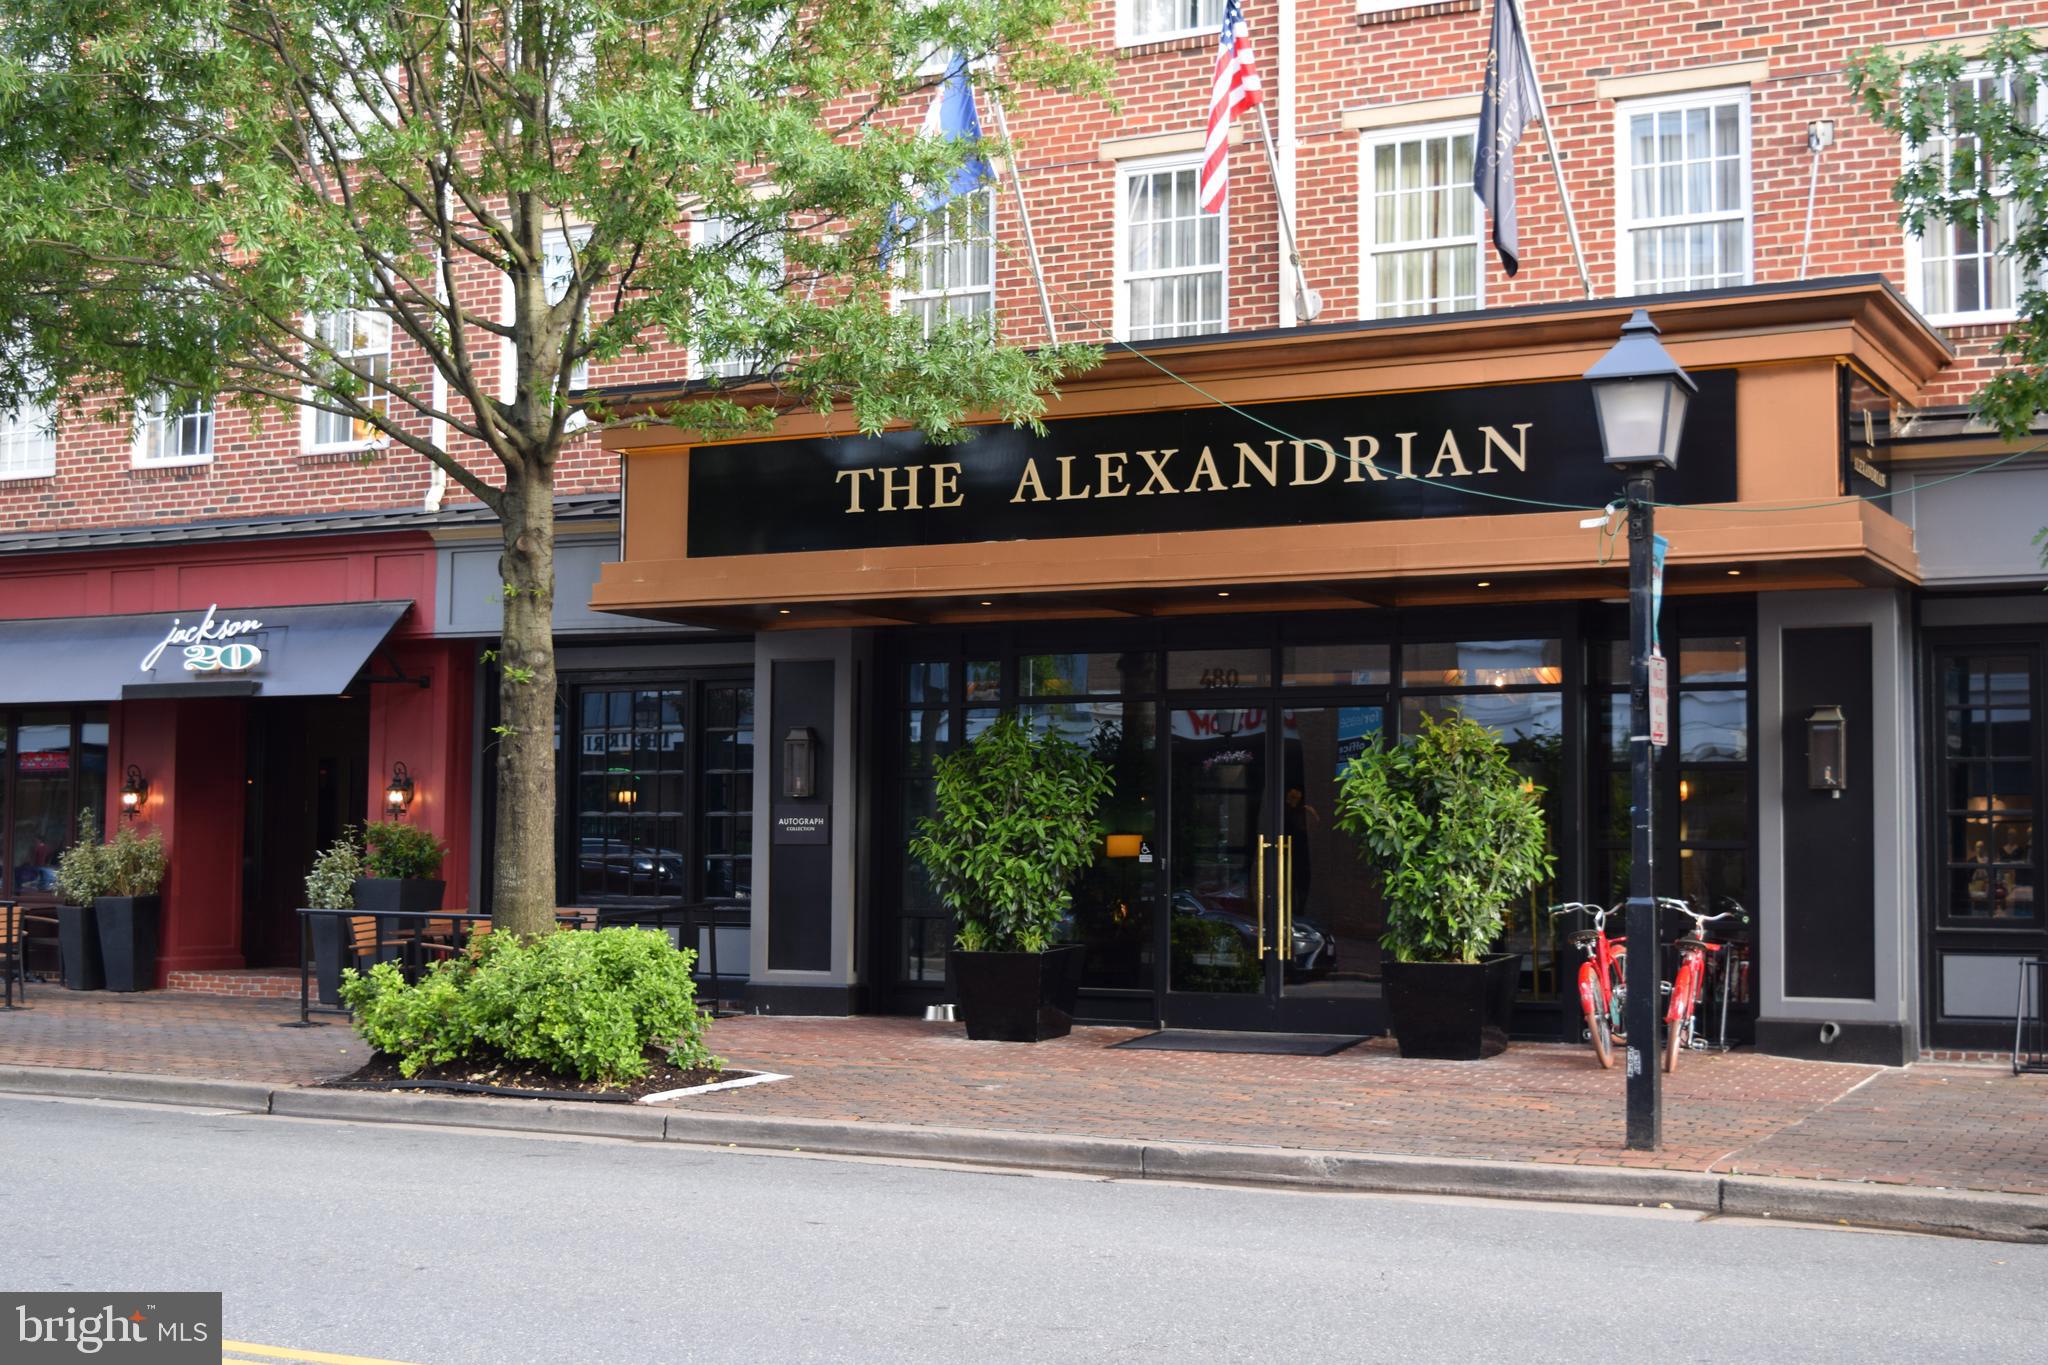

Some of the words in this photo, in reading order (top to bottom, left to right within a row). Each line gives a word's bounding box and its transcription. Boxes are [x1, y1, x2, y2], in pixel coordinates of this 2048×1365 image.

[835, 462, 965, 514] THE
[1010, 423, 1533, 503] ALEXANDRIAN
[140, 603, 263, 672] jackson
[184, 643, 262, 671] 20
[1200, 668, 1239, 687] 480
[778, 817, 825, 826] AUTOGRAPH
